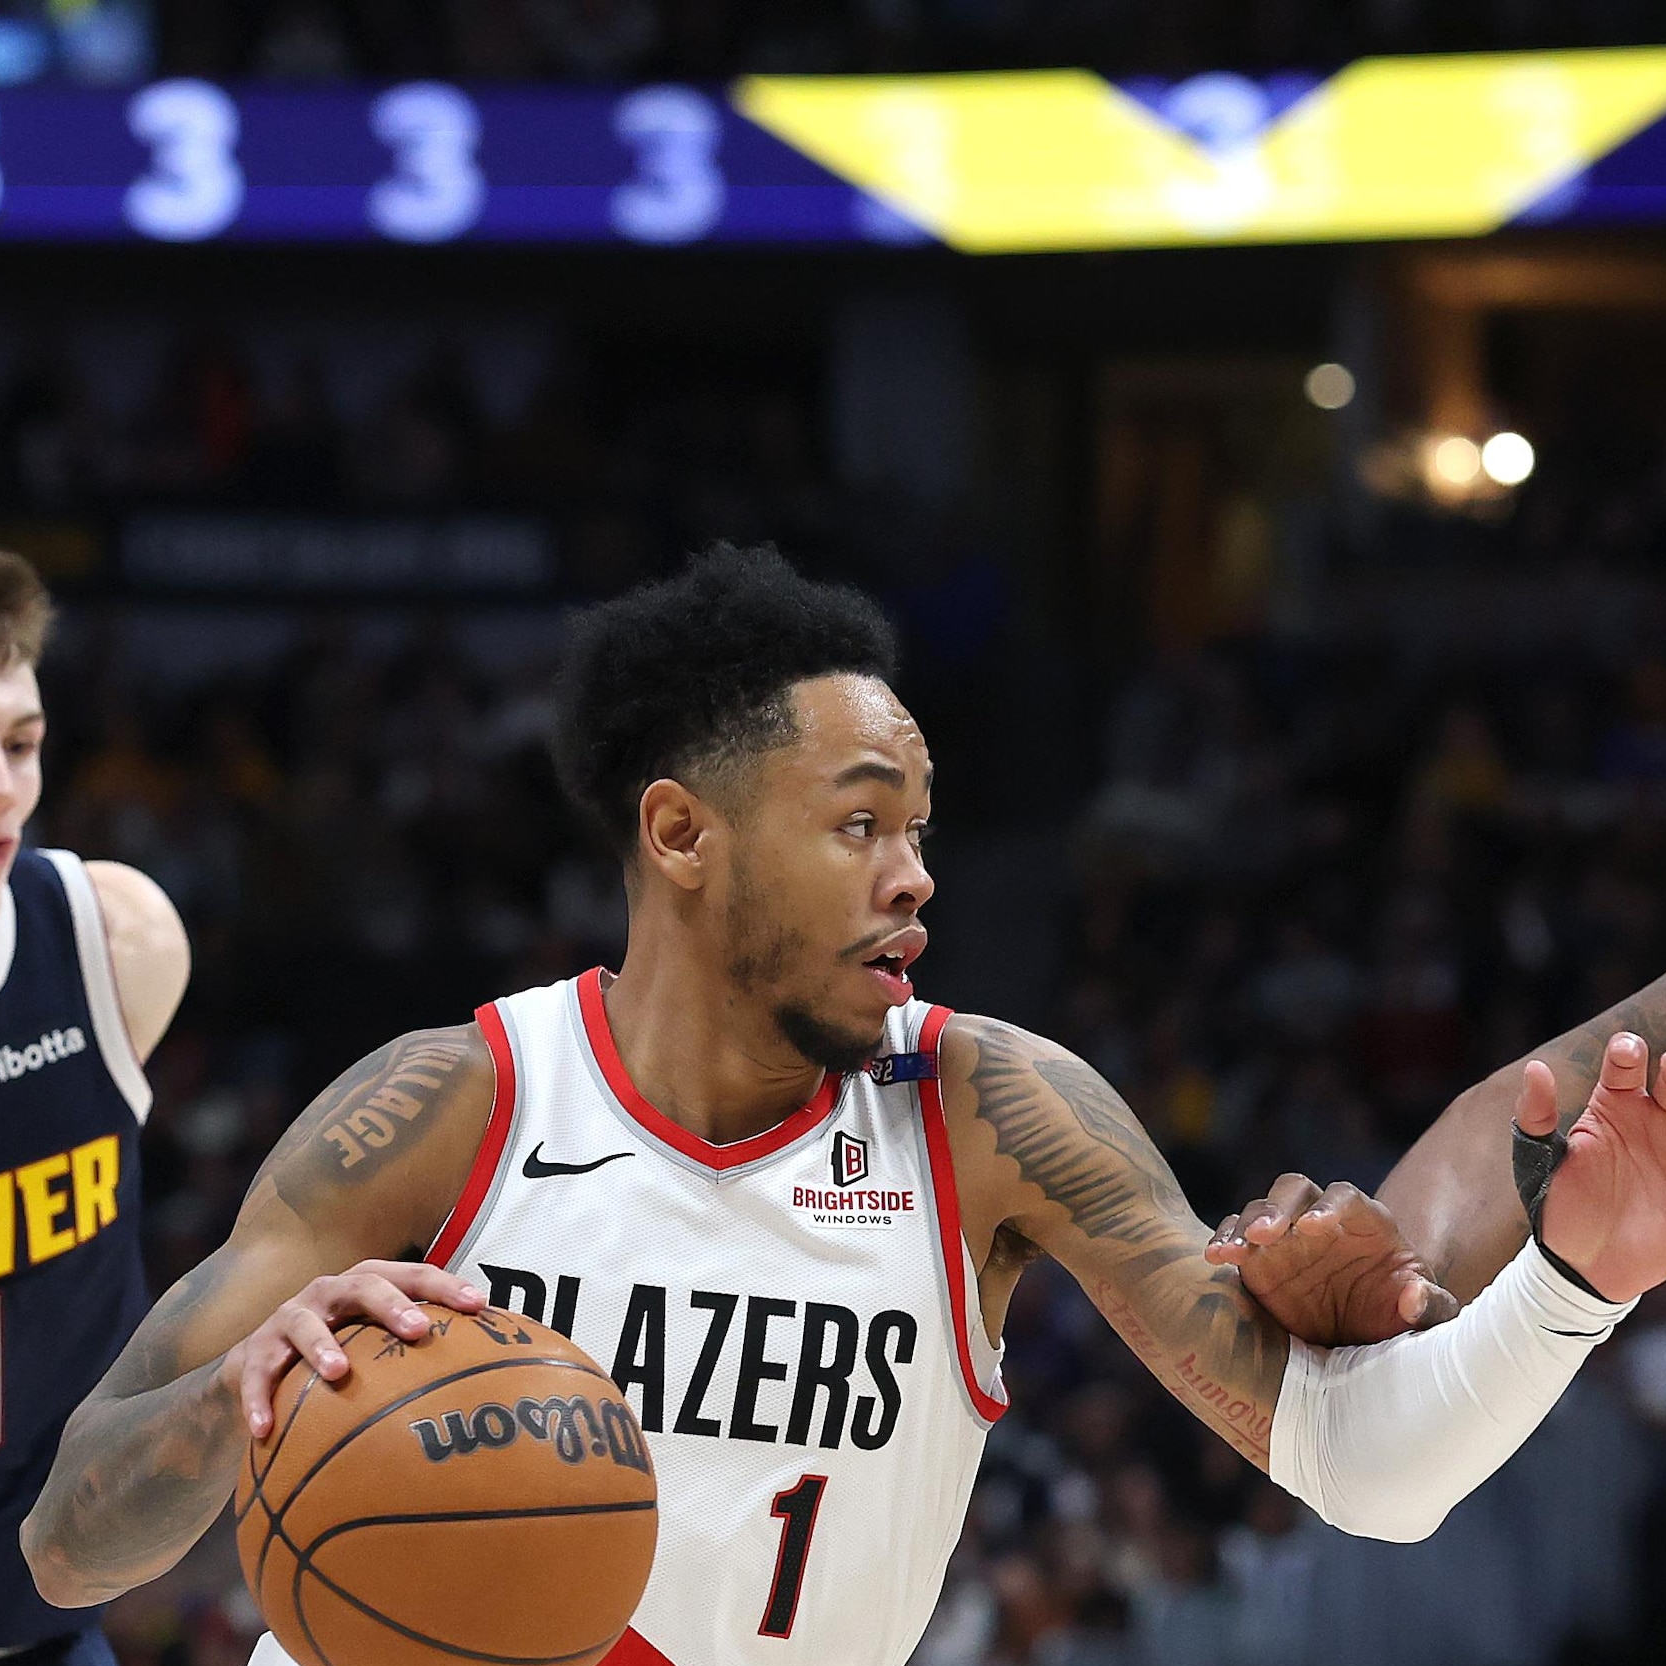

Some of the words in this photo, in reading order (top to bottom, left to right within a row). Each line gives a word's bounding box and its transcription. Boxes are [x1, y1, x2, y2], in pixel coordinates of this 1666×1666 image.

[124, 79, 244, 242] 3
[367, 80, 485, 244] 3
[610, 83, 724, 244] 3
[792, 1186, 914, 1211] BRIGHTSIDE
[813, 1214, 892, 1225] WINDOWS
[410, 1395, 651, 1477] Wilson
[757, 1474, 828, 1639] 1
